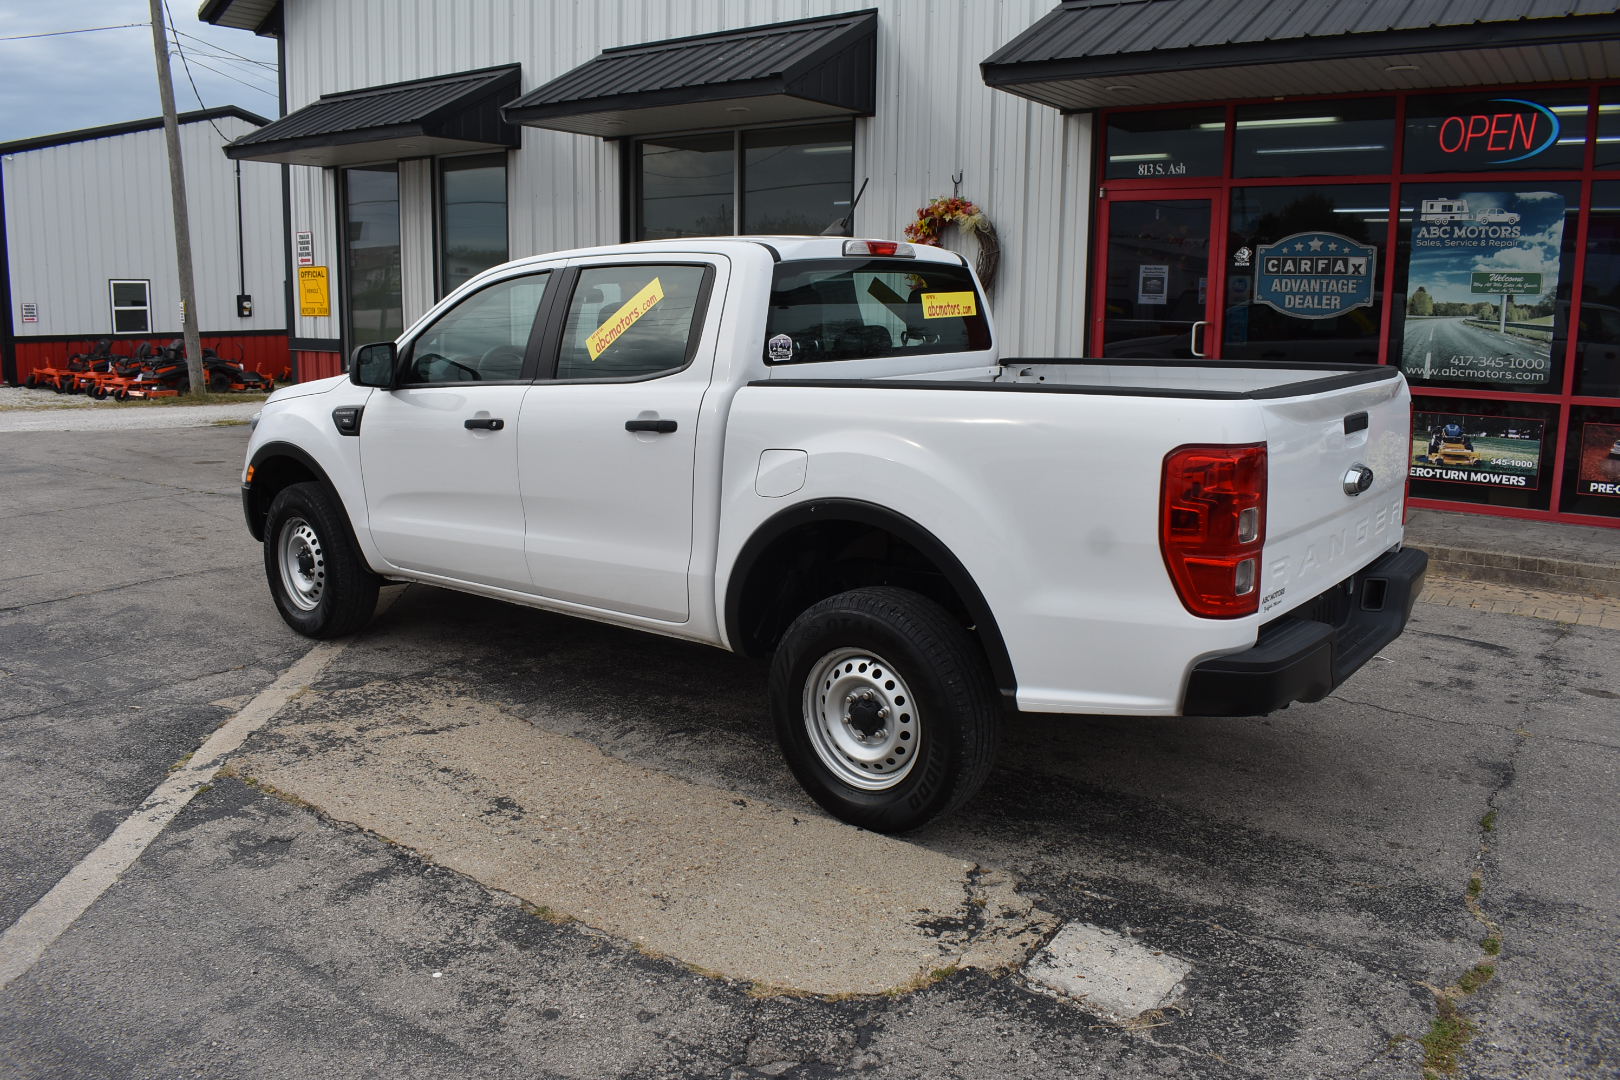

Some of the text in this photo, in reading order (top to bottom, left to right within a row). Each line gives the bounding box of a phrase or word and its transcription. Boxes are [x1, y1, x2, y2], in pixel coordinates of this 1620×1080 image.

[1439, 112, 1538, 153] OPEN
[1138, 162, 1186, 176] 813 S. Ash
[1417, 226, 1521, 239] ABC MOTORS
[1416, 239, 1519, 248] Sales, Service & Repair
[301, 270, 326, 278] OFFICIAL
[1268, 259, 1363, 275] CARFAX
[1489, 273, 1525, 282] Welcome
[1271, 278, 1357, 294] ADVANTAGE
[928, 301, 973, 317] abcmotors.com
[1284, 294, 1341, 309] DEALER
[595, 294, 658, 354] abcmotors.com
[1450, 355, 1545, 370] 417-345-1000
[1406, 366, 1544, 381] www.abcmotors.com
[1490, 458, 1533, 468] 345-1000
[1470, 471, 1526, 487] MOWERS
[1268, 498, 1402, 593] RANGER
